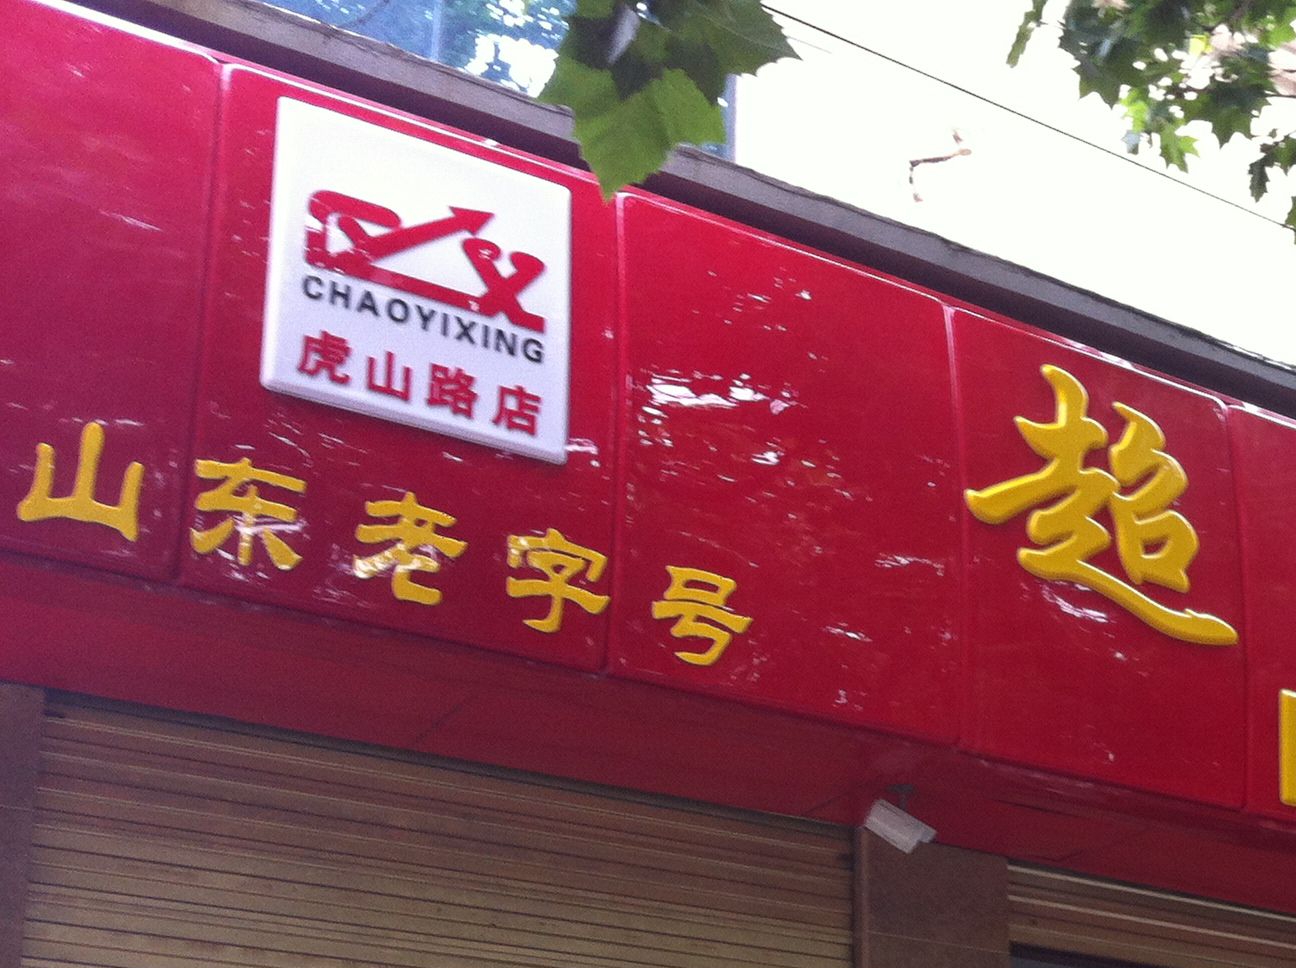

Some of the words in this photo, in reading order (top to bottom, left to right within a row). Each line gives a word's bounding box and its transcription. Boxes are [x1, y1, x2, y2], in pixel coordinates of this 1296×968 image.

[302, 274, 545, 364] CHAOYIXING
[298, 330, 542, 437] 虎山路店
[16, 422, 753, 666] 山东老字号
